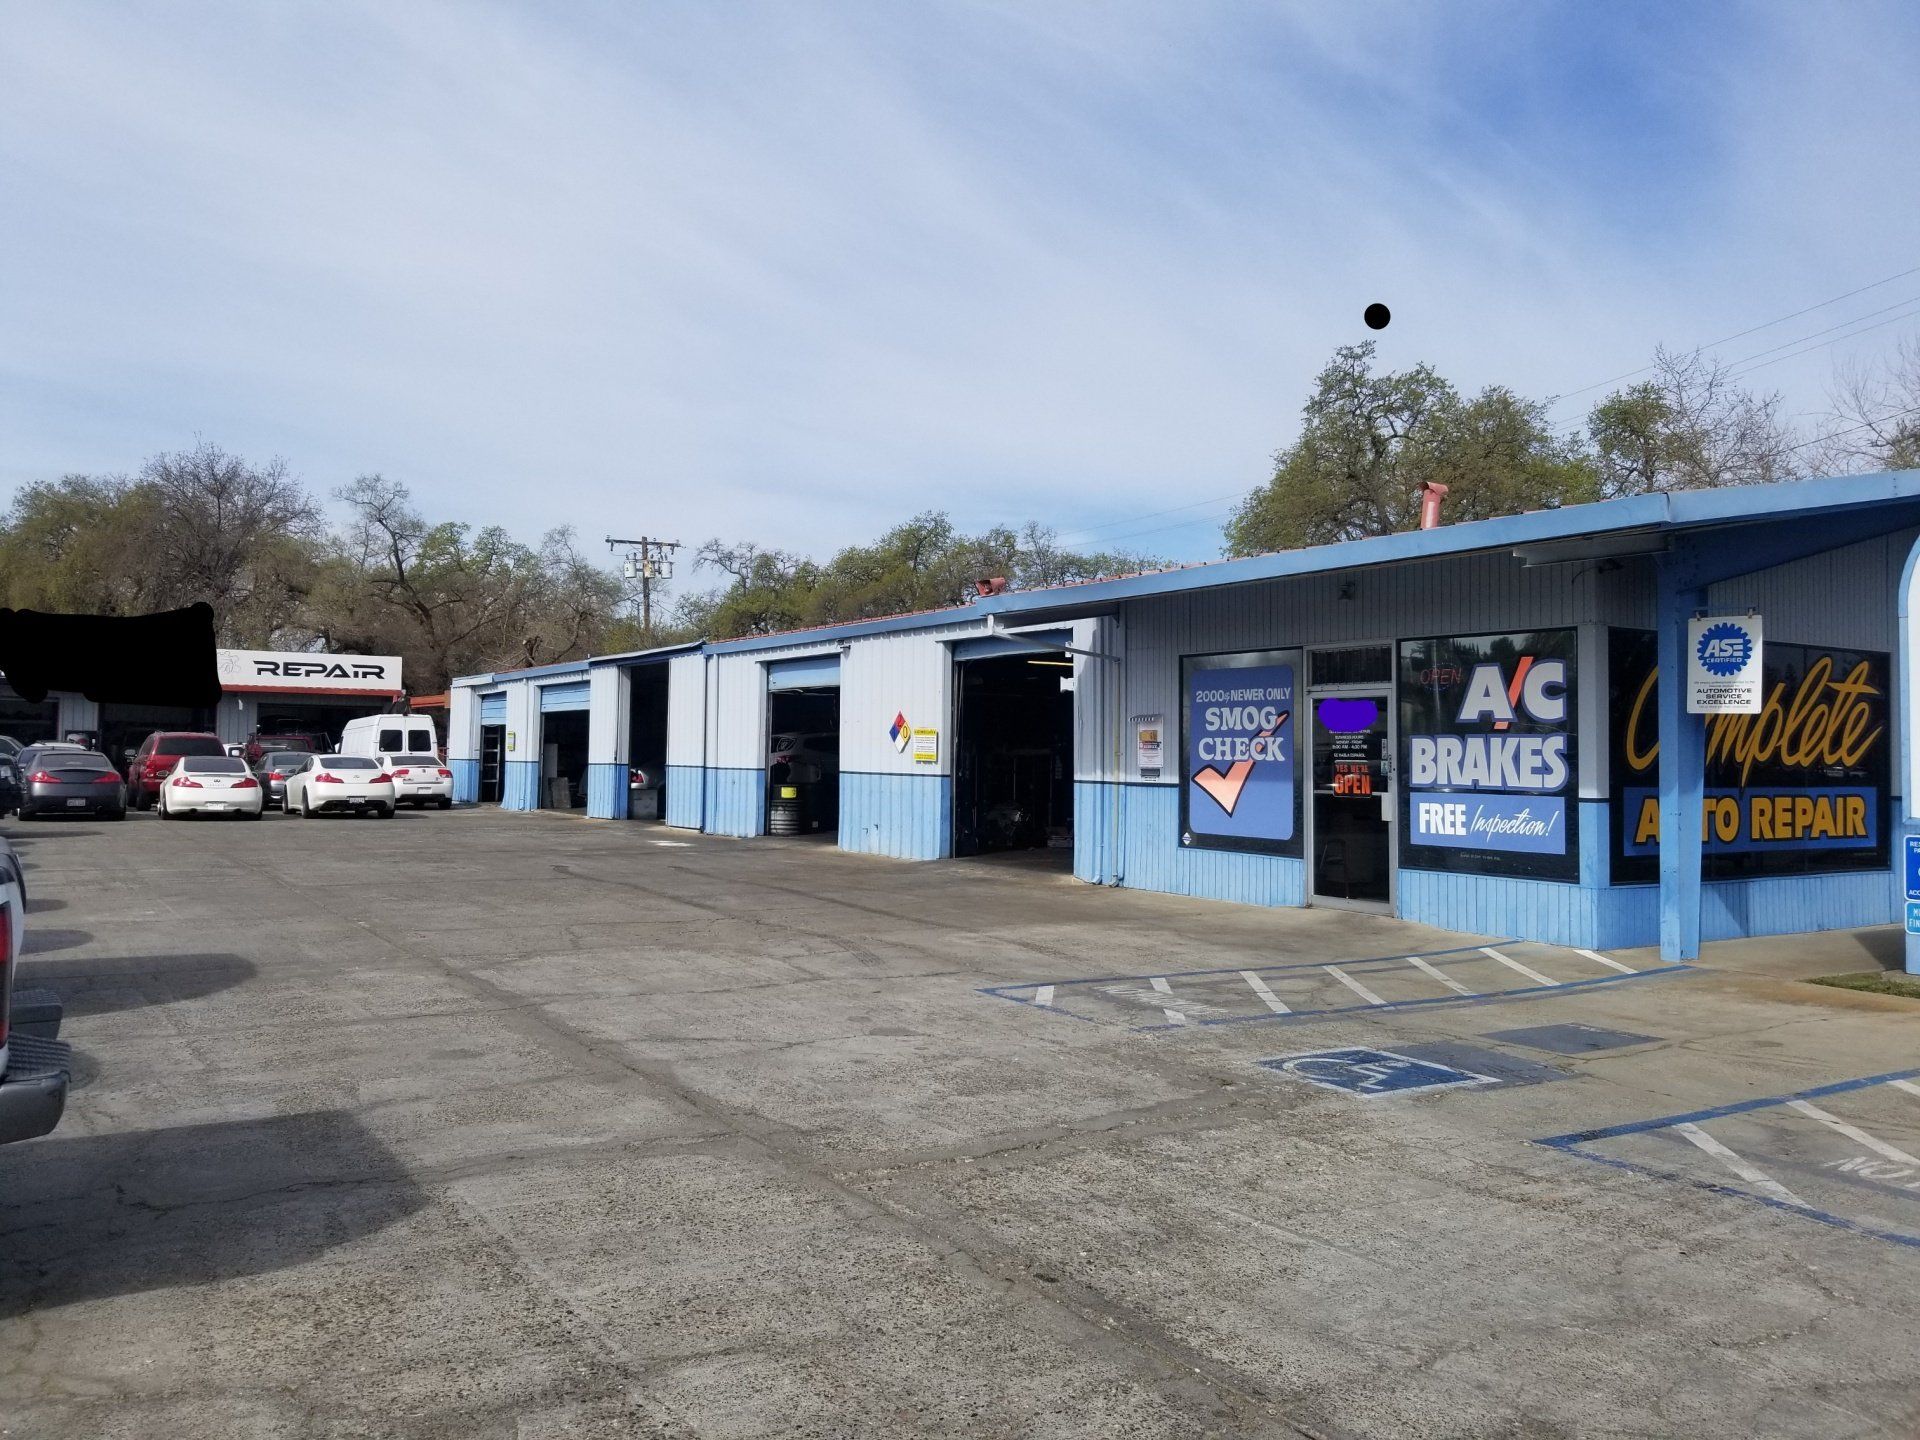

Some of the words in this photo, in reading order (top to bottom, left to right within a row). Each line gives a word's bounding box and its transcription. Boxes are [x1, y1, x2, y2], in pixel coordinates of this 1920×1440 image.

[1703, 638, 1744, 658] ASE
[253, 660, 385, 680] REPAIR
[1420, 667, 1462, 685] OPEN
[1196, 690, 1224, 703] 2000
[1230, 688, 1265, 702] NEWER
[1266, 687, 1291, 700] ONLY
[1456, 656, 1567, 730] A/C
[1205, 705, 1278, 731] SMOG
[1626, 656, 1883, 788] Cmplete
[1198, 736, 1286, 762] CHECK
[1409, 734, 1568, 791] BRAKES
[1334, 774, 1371, 794] OPEN
[1418, 802, 1467, 836] FREE
[1469, 804, 1560, 842] Inspection!
[1635, 797, 1740, 843] ATO
[1751, 796, 1868, 840] REPAIR
